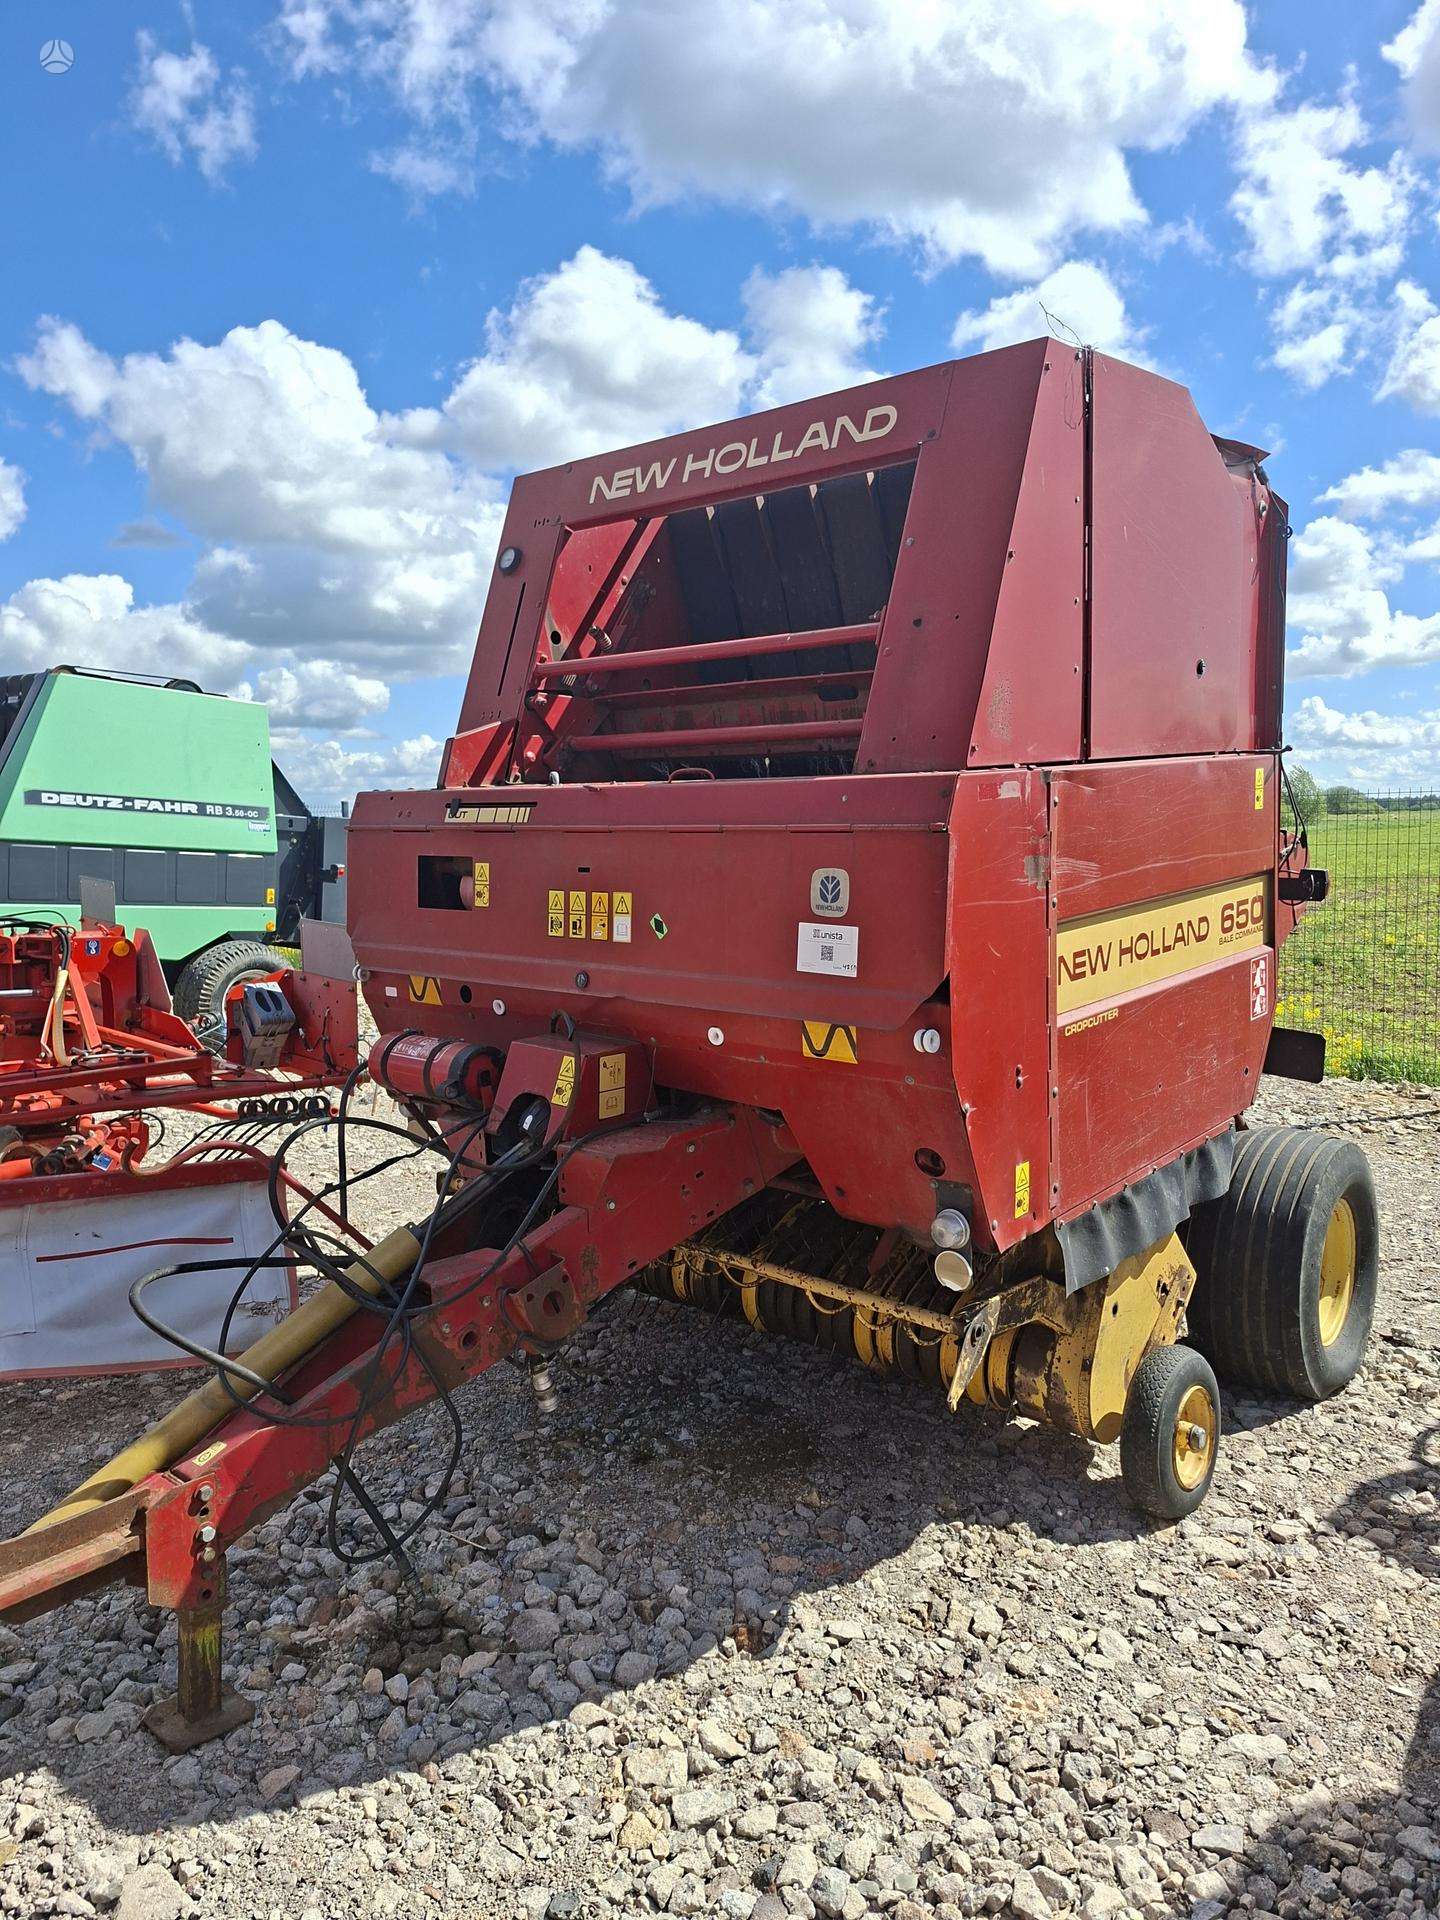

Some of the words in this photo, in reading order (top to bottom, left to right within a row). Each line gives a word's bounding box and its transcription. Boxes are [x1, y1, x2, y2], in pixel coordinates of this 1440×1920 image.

[589, 458, 677, 504] NEW
[682, 405, 898, 482] HOLLAND
[41, 792, 199, 814] DEUTZ-FAHR
[206, 805, 223, 815] RB
[821, 931, 843, 940] unista
[1058, 941, 1112, 986] NEW
[1119, 915, 1210, 968] HOLLAND
[1220, 895, 1264, 934] 650
[1219, 934, 1234, 945] BALE
[1235, 924, 1264, 940] COMMAND
[1065, 1008, 1119, 1036] CROPCUTTER
